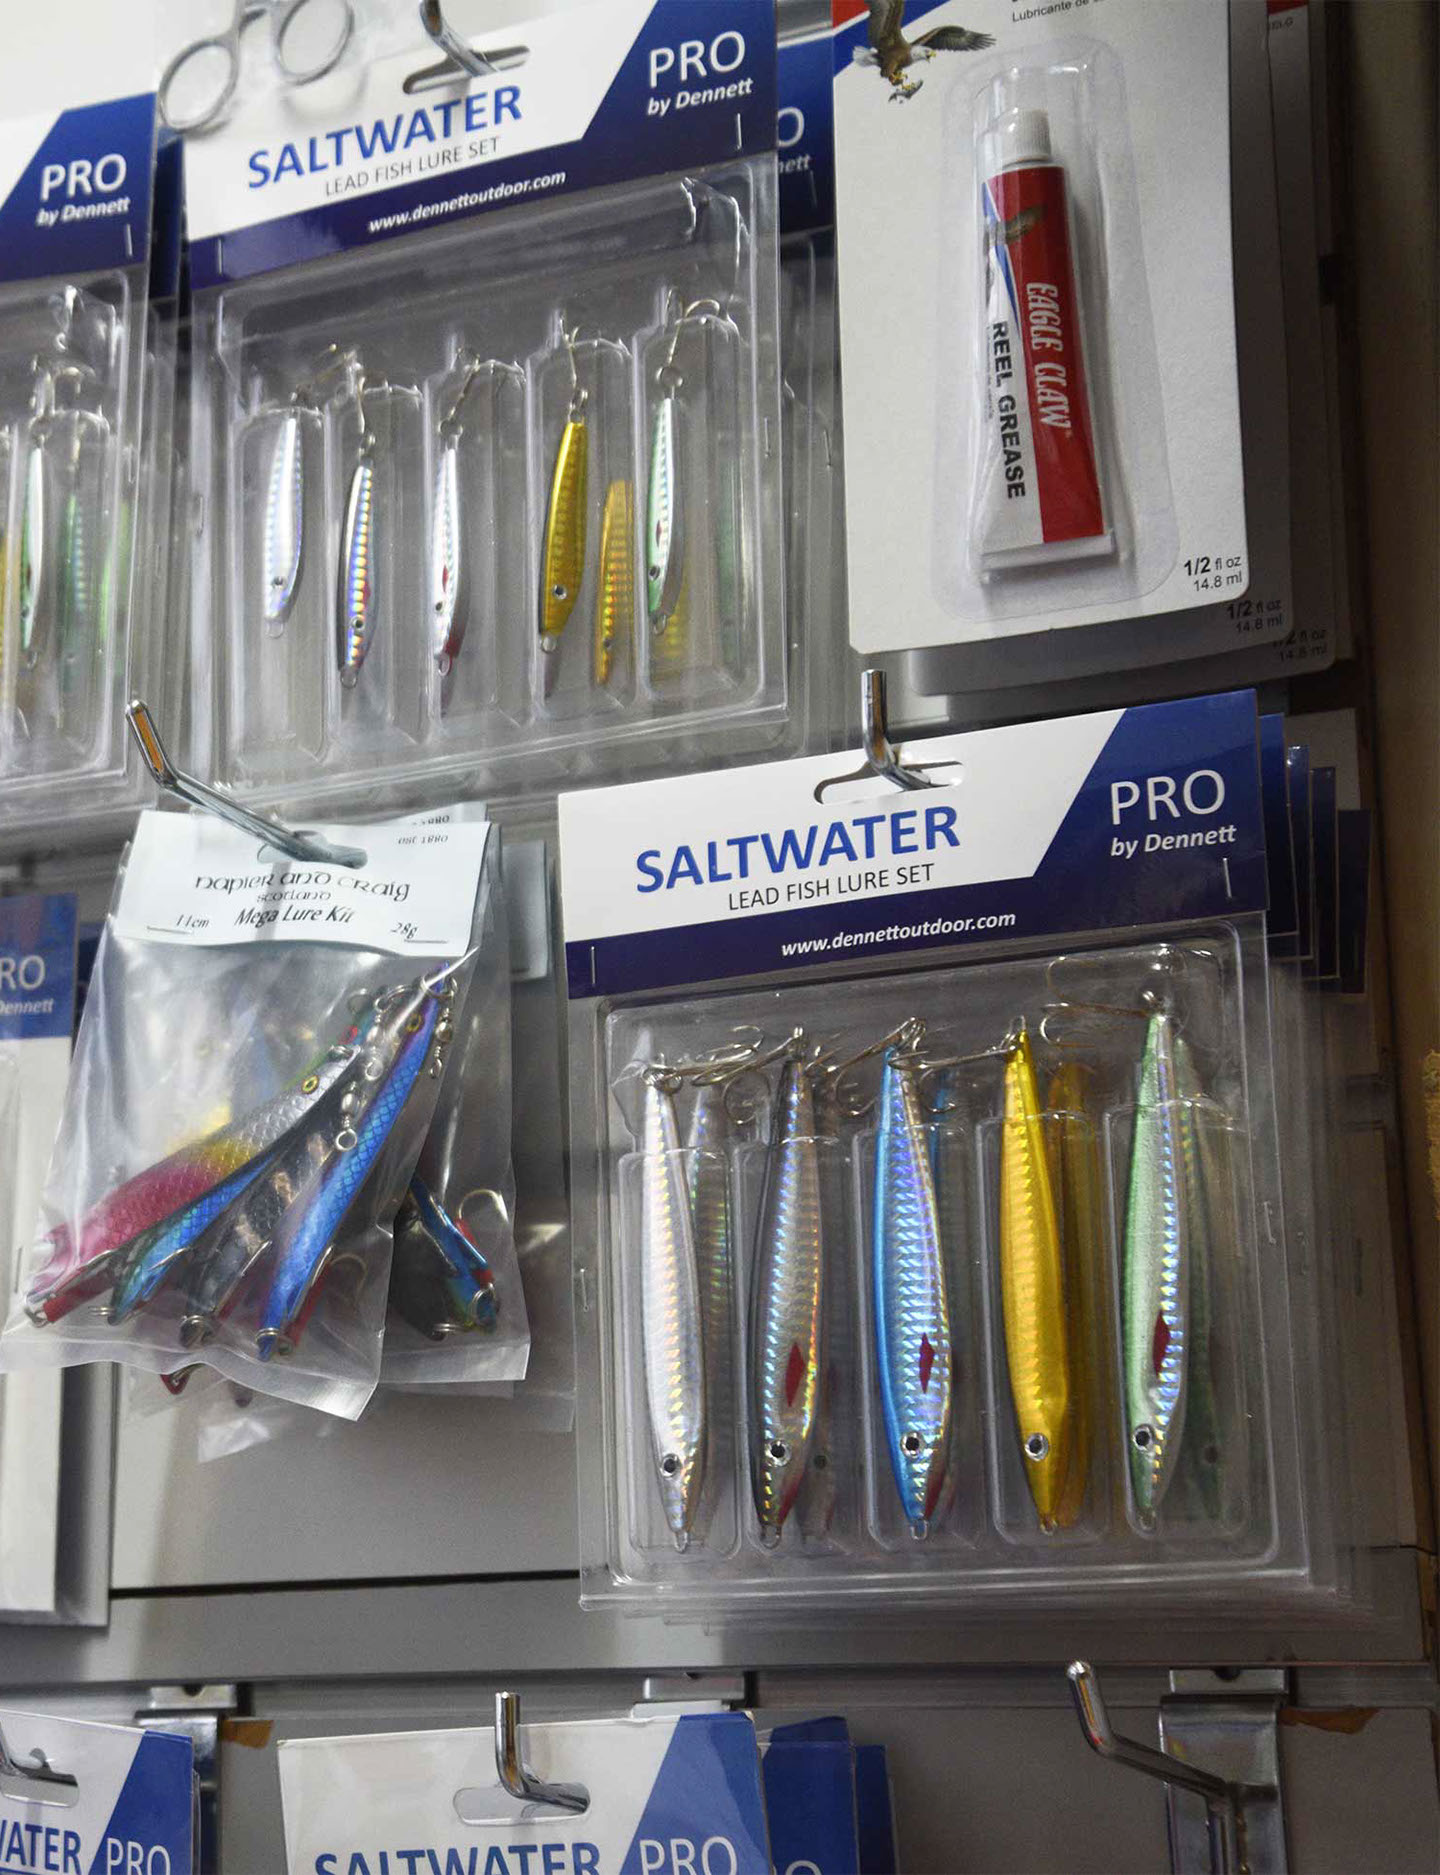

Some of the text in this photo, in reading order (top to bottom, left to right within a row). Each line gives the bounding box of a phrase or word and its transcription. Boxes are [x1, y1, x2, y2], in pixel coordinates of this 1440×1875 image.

[1012, 1, 1072, 22] Lubricante
[649, 30, 746, 88] PRO
[646, 77, 754, 117] by Dennett
[248, 85, 522, 188] SALTWATER
[41, 153, 127, 202] PRO
[325, 136, 500, 197] LEAD FISH LURE SET
[36, 196, 130, 227] by Dennett
[368, 171, 566, 233] www.dennettoutdoor.com
[1026, 282, 1072, 429] EAGLE CLAW
[993, 321, 1026, 499] REEL GREASE
[1184, 556, 1241, 576] 1/2 fl oz
[1194, 572, 1242, 591] 14.8 ml
[1111, 769, 1225, 825] PRO
[636, 806, 960, 893] SALTWATER
[1111, 825, 1237, 859] by Dennett
[728, 863, 935, 911] LEAD FISH LURE SET
[234, 904, 357, 929] Mega Lure Kit
[390, 922, 418, 939] 28g
[781, 912, 1015, 957] www.dennettoutdoor.com
[106, 1837, 171, 1875] PRO
[639, 1836, 738, 1875] PRO
